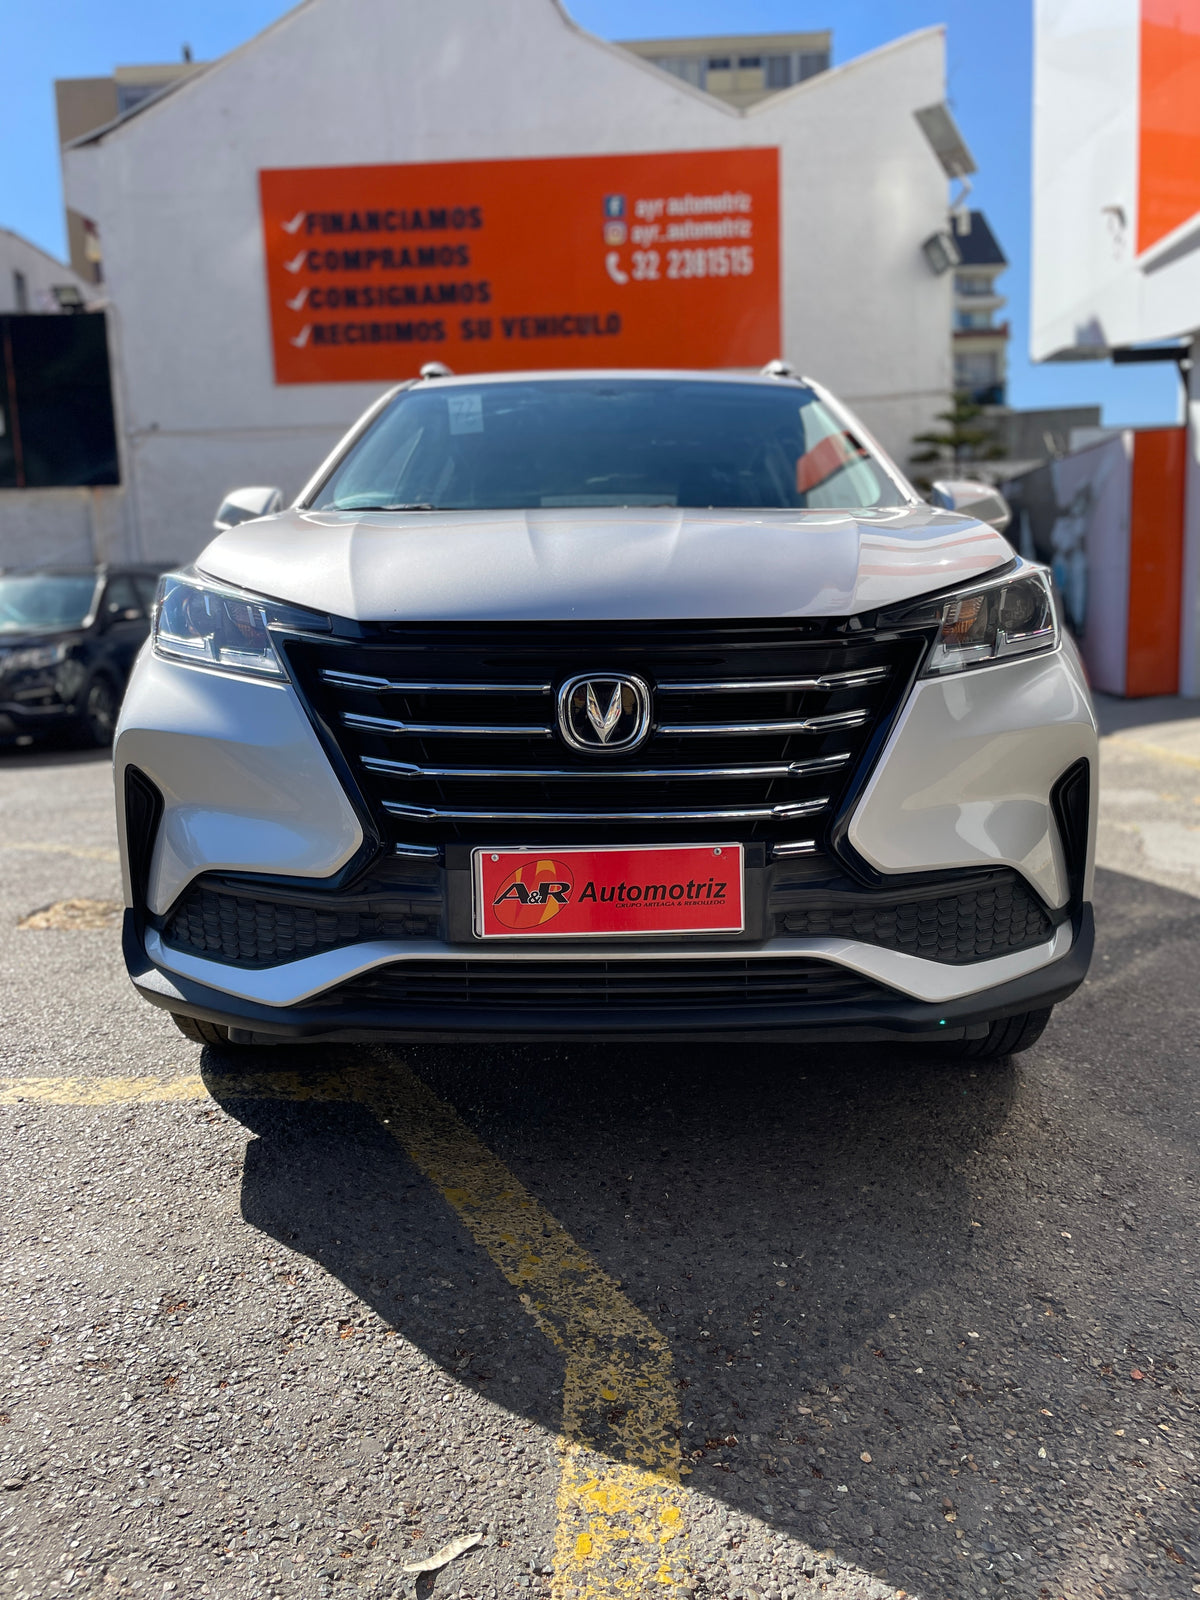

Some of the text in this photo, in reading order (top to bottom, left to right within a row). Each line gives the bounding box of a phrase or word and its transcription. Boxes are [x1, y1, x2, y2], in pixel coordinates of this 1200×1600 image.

[666, 192, 752, 215] automotriz
[306, 206, 483, 233] FINANCIAMOS
[308, 245, 470, 272] COMPRAMOS
[632, 250, 660, 280] 32
[311, 283, 491, 309] CONSIGNAMOS
[313, 312, 621, 345] RECIBIMOS SU VEHICULO
[578, 877, 727, 903] Automotriz
